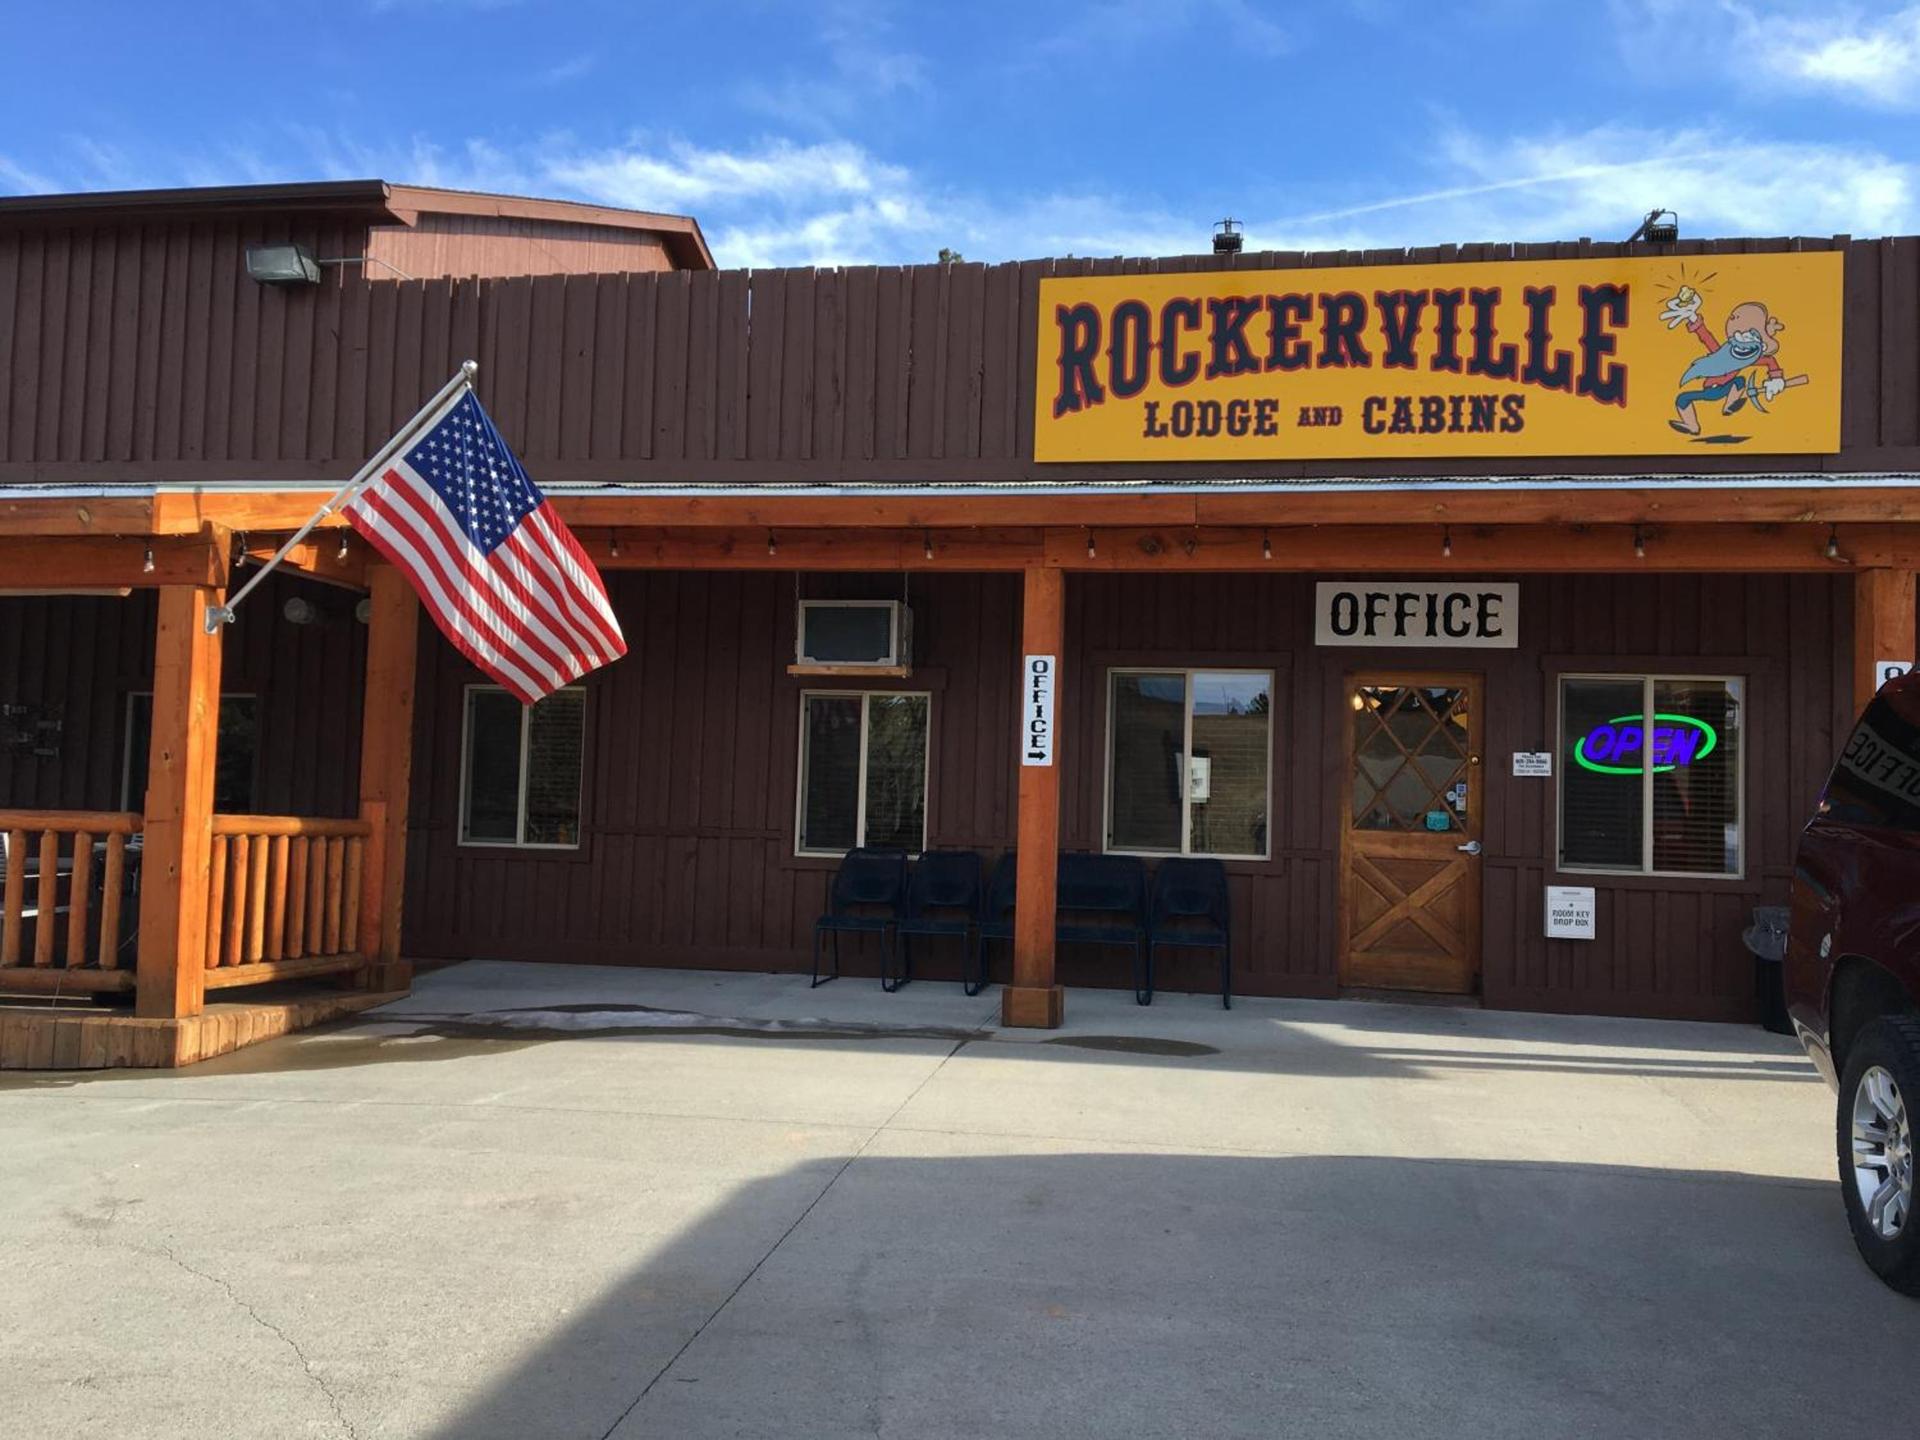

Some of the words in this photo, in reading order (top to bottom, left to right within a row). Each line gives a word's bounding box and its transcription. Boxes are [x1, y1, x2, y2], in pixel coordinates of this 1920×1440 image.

[1053, 283, 1630, 419] ROCKERVILLE
[1143, 399, 1279, 438] LODGE
[1297, 406, 1342, 427] AND
[1362, 394, 1525, 434] CABINS
[1330, 591, 1503, 638] OFFICE
[1030, 659, 1049, 748] OFFICE
[1583, 725, 1701, 767] OPEN
[1552, 909, 1574, 918] ROOM
[1576, 910, 1590, 918] KEY
[1553, 918, 1574, 926] DROP
